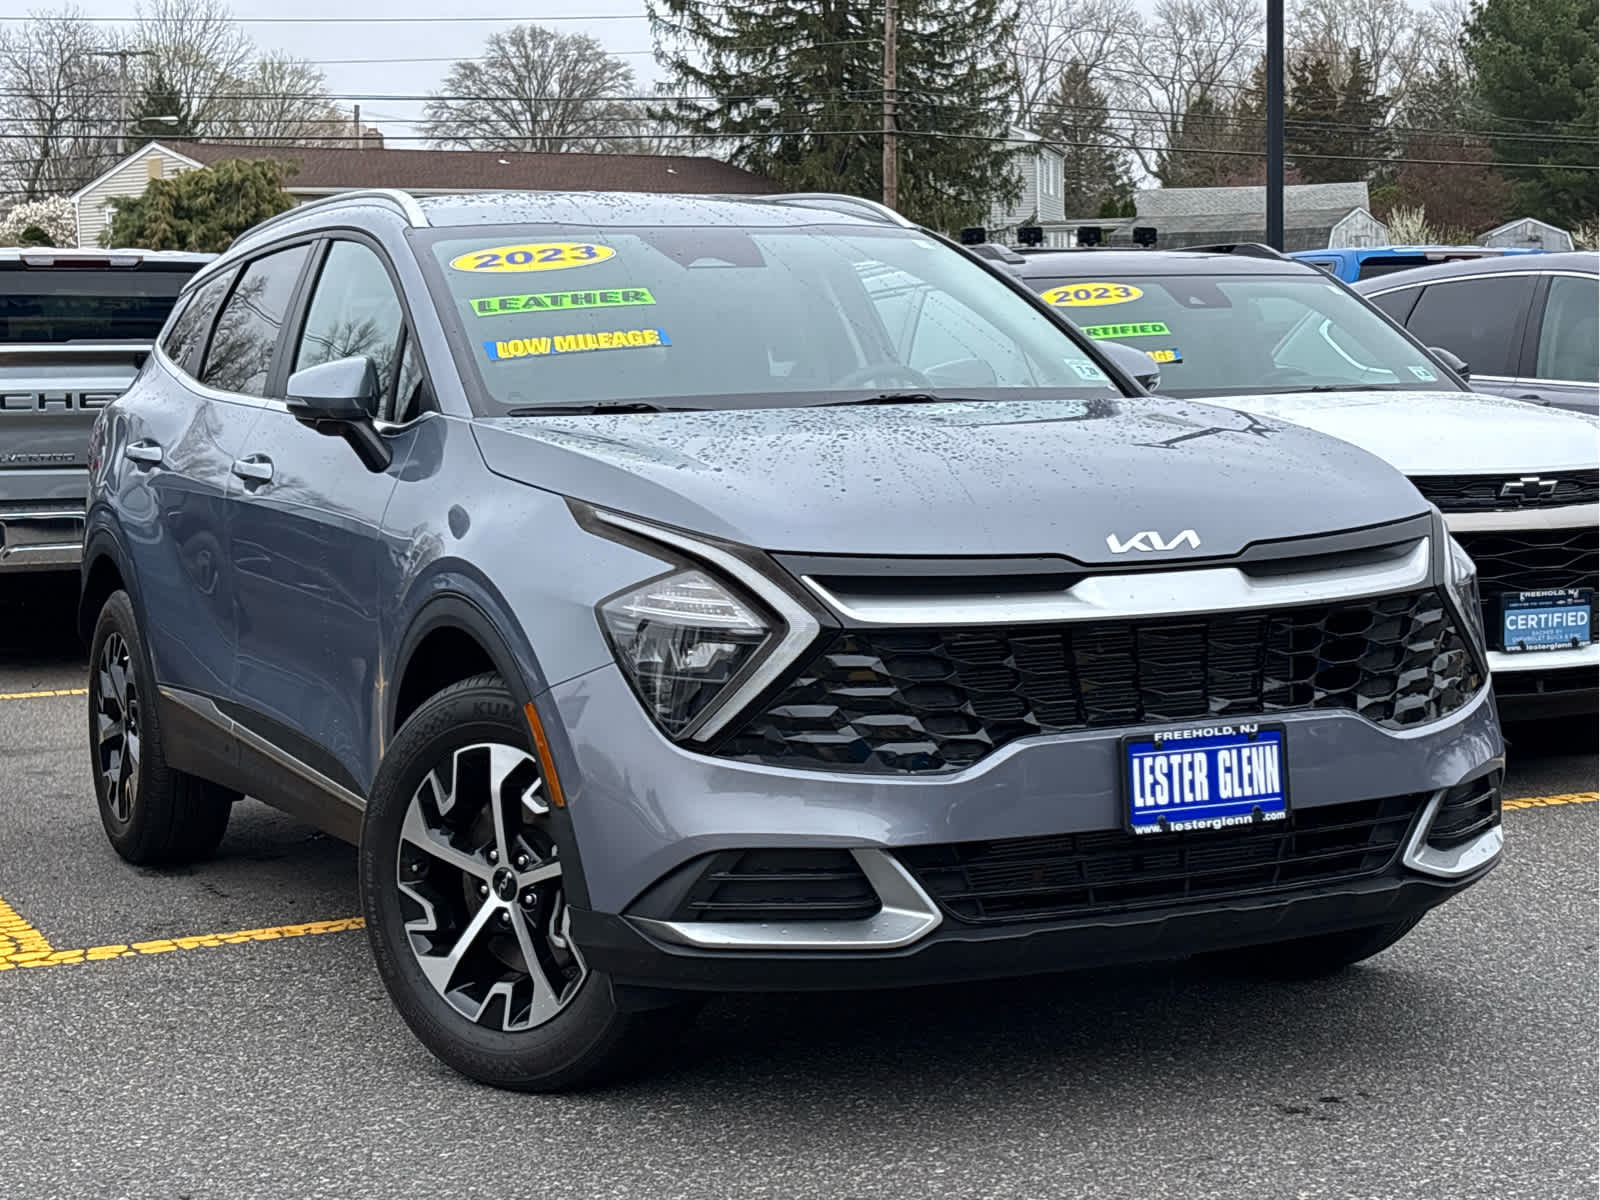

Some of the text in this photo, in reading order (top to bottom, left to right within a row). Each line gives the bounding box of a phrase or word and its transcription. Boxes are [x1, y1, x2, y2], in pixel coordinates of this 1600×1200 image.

[473, 245, 600, 269] 2023
[477, 289, 647, 313] LEATHER
[1053, 286, 1133, 304] 2023
[1081, 324, 1166, 337] RTIFIED
[496, 329, 662, 359] LOW MILEAGE
[1106, 529, 1201, 553] KIA
[1506, 611, 1588, 630] CERTIFIED
[1154, 724, 1259, 742] FREEHOLD, NJ
[1132, 744, 1281, 808] LESTER GLENN
